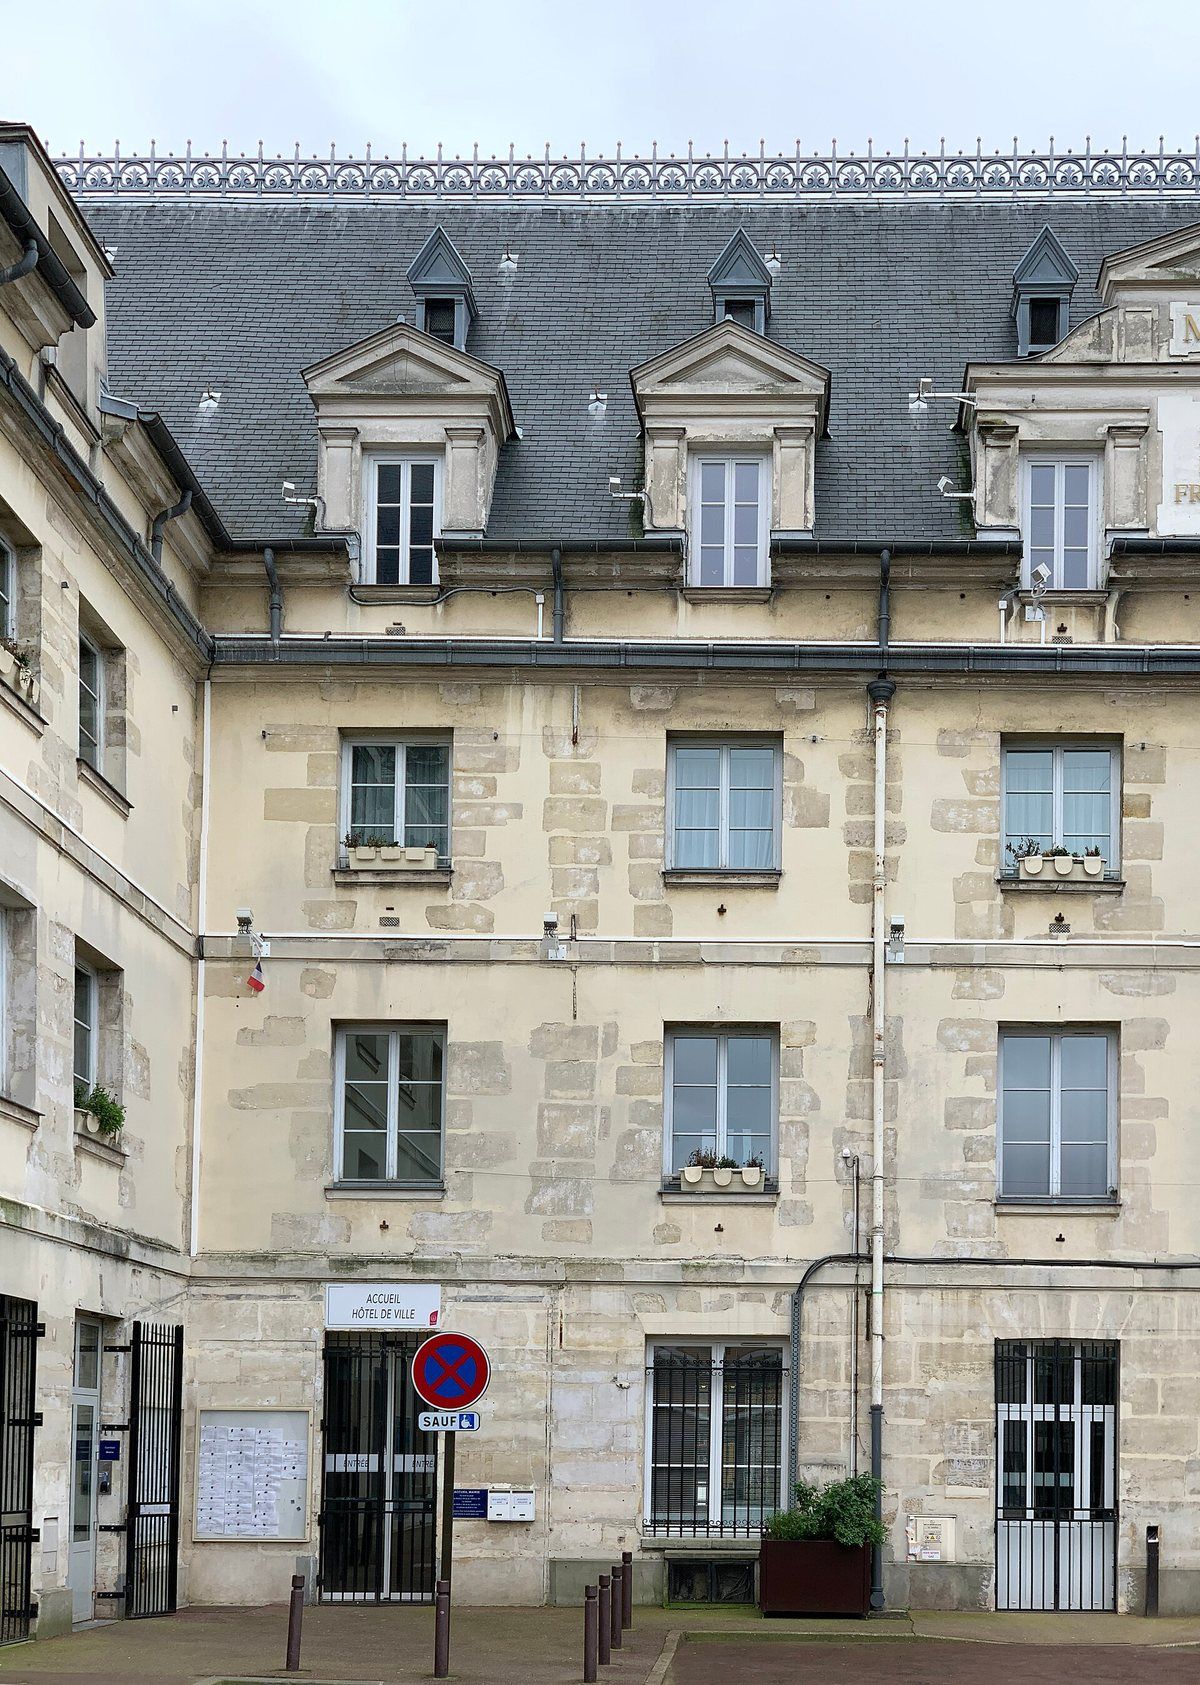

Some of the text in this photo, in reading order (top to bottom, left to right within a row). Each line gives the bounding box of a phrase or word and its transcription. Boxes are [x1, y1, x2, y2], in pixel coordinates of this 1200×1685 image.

[366, 1293, 401, 1304] ACCUEIL
[352, 1308, 415, 1320] HÔTEL DE VILLE
[423, 1416, 457, 1427] SAUF
[411, 1458, 435, 1468] ENTRÉ
